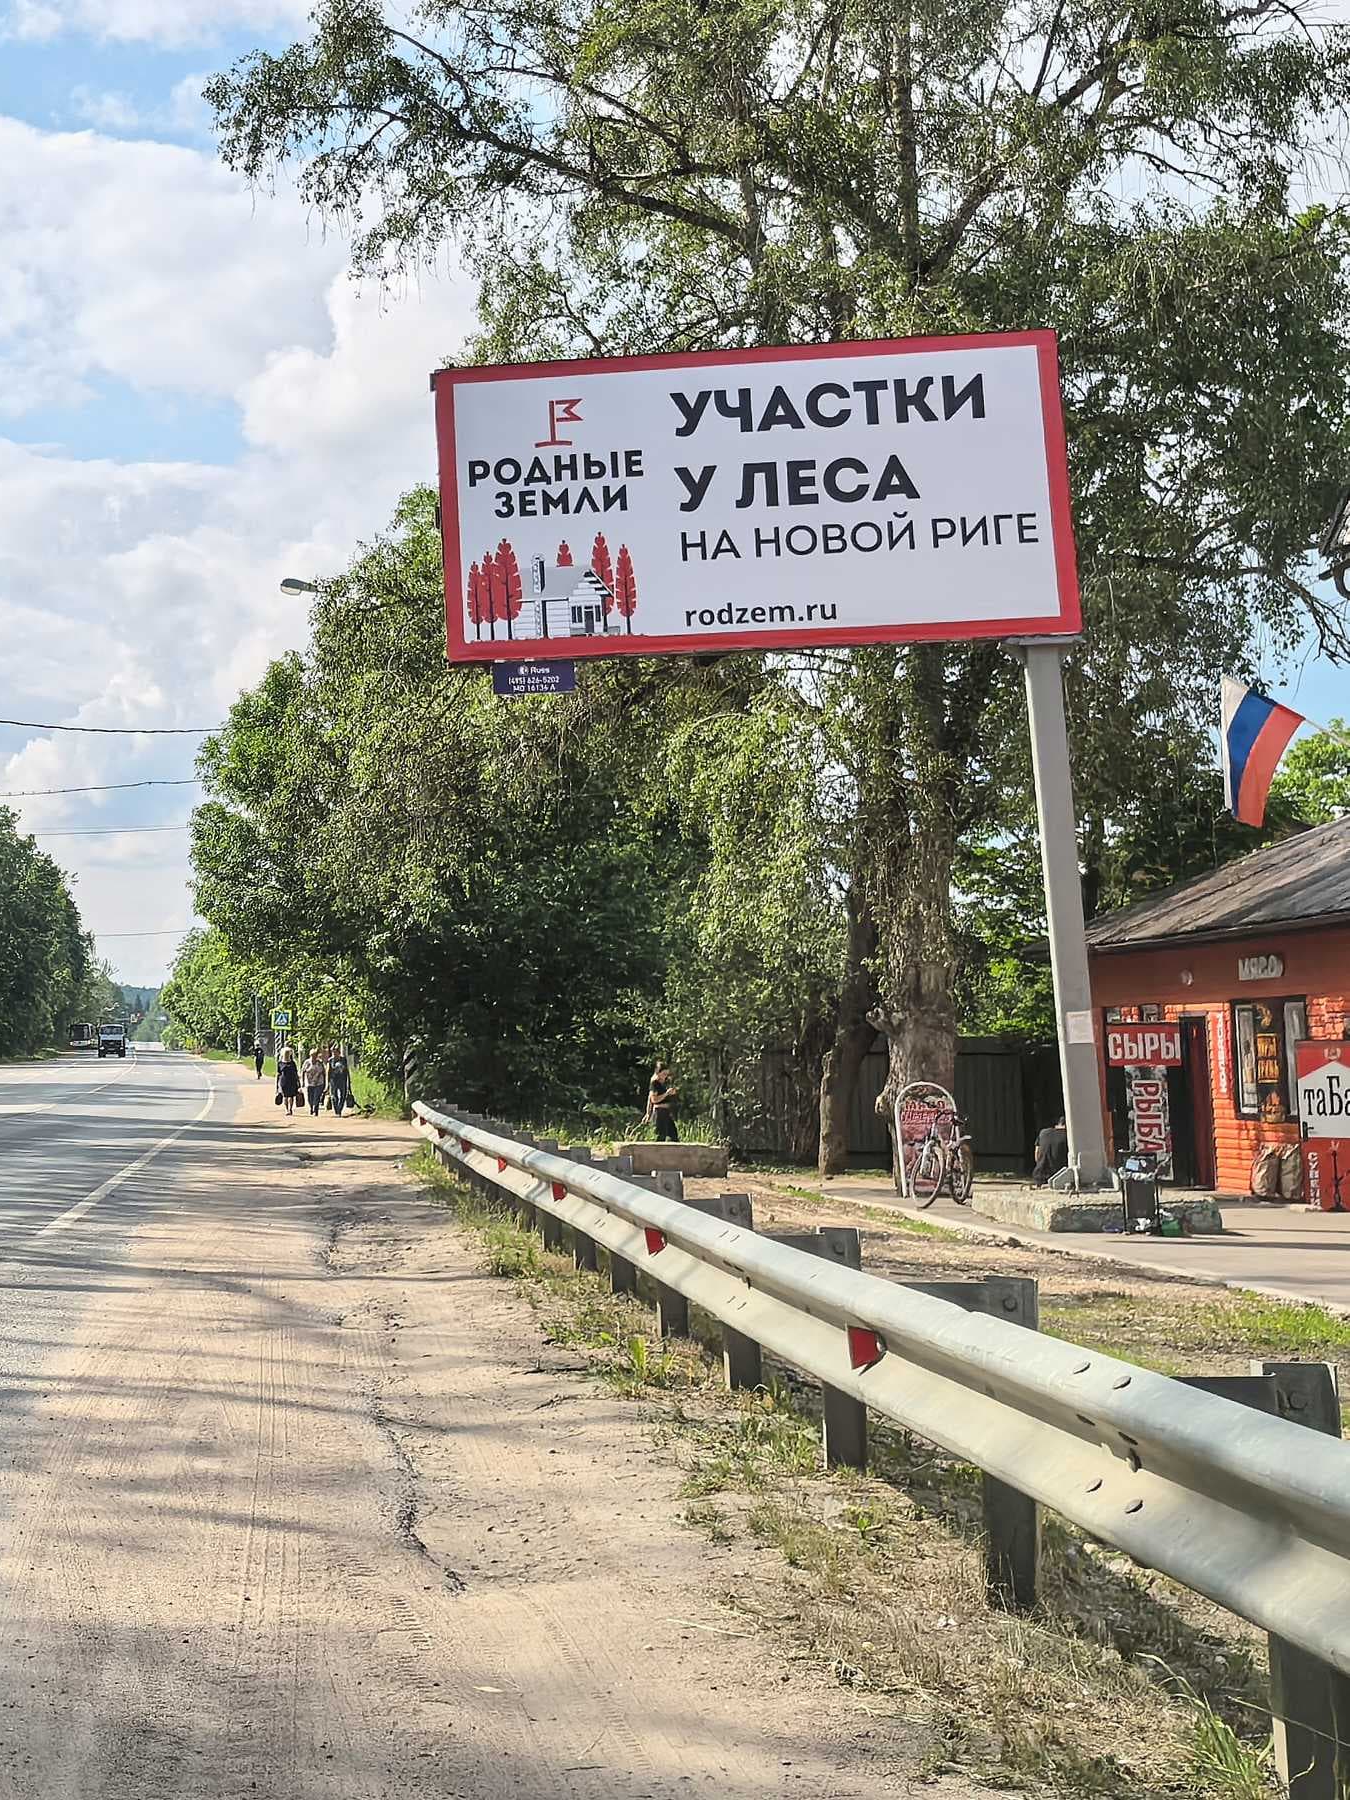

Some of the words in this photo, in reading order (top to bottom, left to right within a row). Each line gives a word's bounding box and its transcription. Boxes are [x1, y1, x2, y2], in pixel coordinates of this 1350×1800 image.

[669, 373, 986, 437] УЧАСТКИ
[468, 450, 644, 487] РОДНЫЕ
[673, 465, 717, 512] У
[735, 454, 921, 509] ЛЕСА
[494, 484, 628, 519] ЗЕМЛИ
[680, 529, 741, 562] НА
[754, 511, 916, 558] НОВОЙ
[931, 513, 1039, 549] РИГЕ
[685, 602, 837, 627] rodzem.ru
[1108, 1032, 1181, 1060] СЫРЫ
[1131, 1080, 1166, 1155] РЫБА
